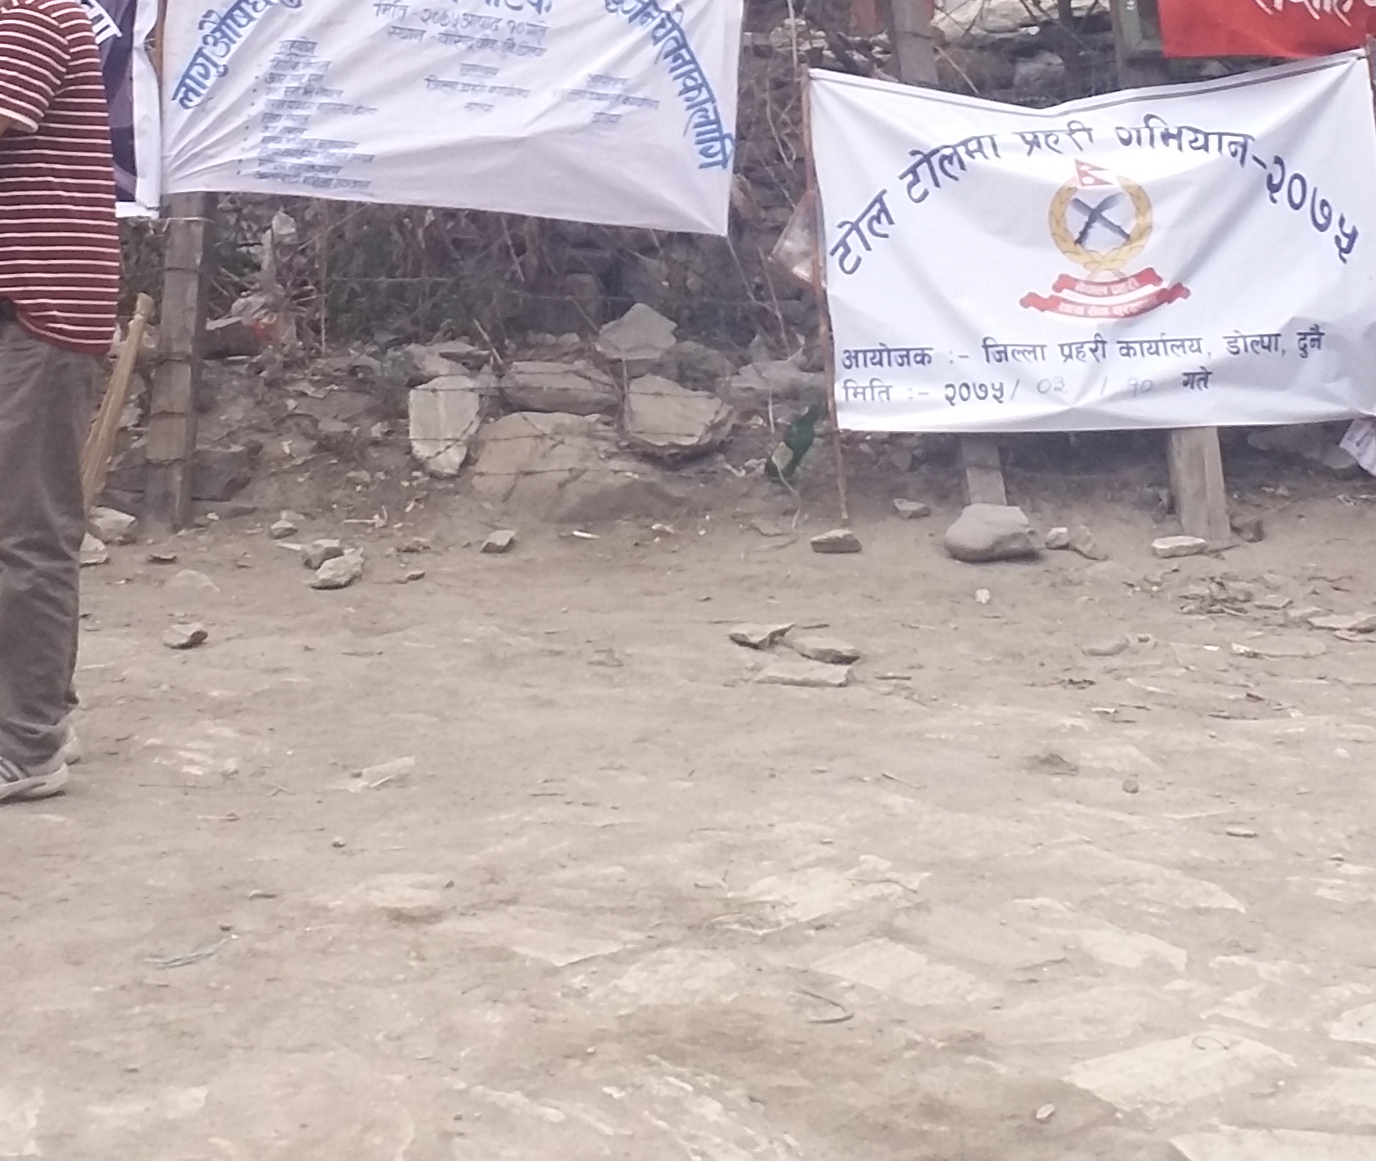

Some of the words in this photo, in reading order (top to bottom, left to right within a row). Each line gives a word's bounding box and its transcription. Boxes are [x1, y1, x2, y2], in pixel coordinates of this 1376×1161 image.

[172, 47, 229, 110] लागु
[829, 189, 895, 275] टोल
[898, 134, 1001, 204] टोलमा
[842, 342, 933, 370] आयोजक
[982, 336, 1047, 364] जिल्ला
[1058, 333, 1107, 363] प्रहरी
[842, 378, 892, 402] मिति
[1182, 365, 1213, 391] गते
